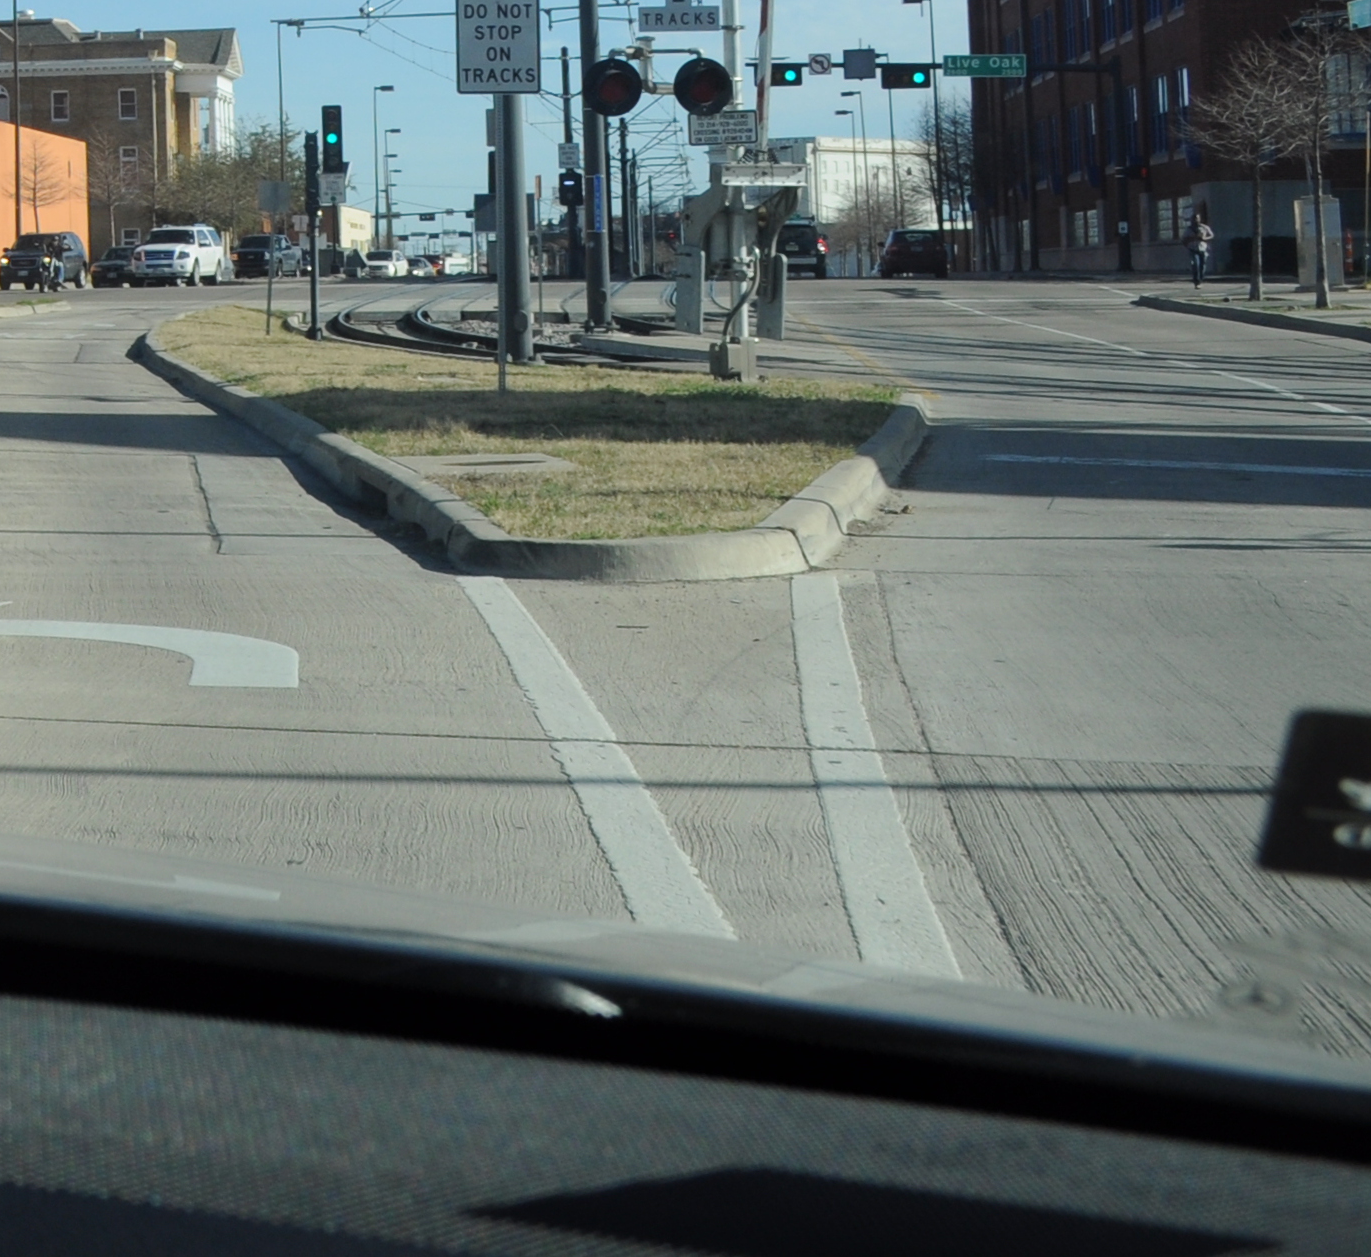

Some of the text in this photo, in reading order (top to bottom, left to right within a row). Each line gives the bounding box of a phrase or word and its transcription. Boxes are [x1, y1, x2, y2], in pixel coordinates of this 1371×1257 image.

[464, 4, 532, 19] DO NOT
[643, 12, 716, 25] TRACKS
[474, 25, 522, 40] STOP
[486, 46, 511, 61] ON
[948, 56, 1021, 68] Live Oak
[462, 68, 536, 83] TRACKS
